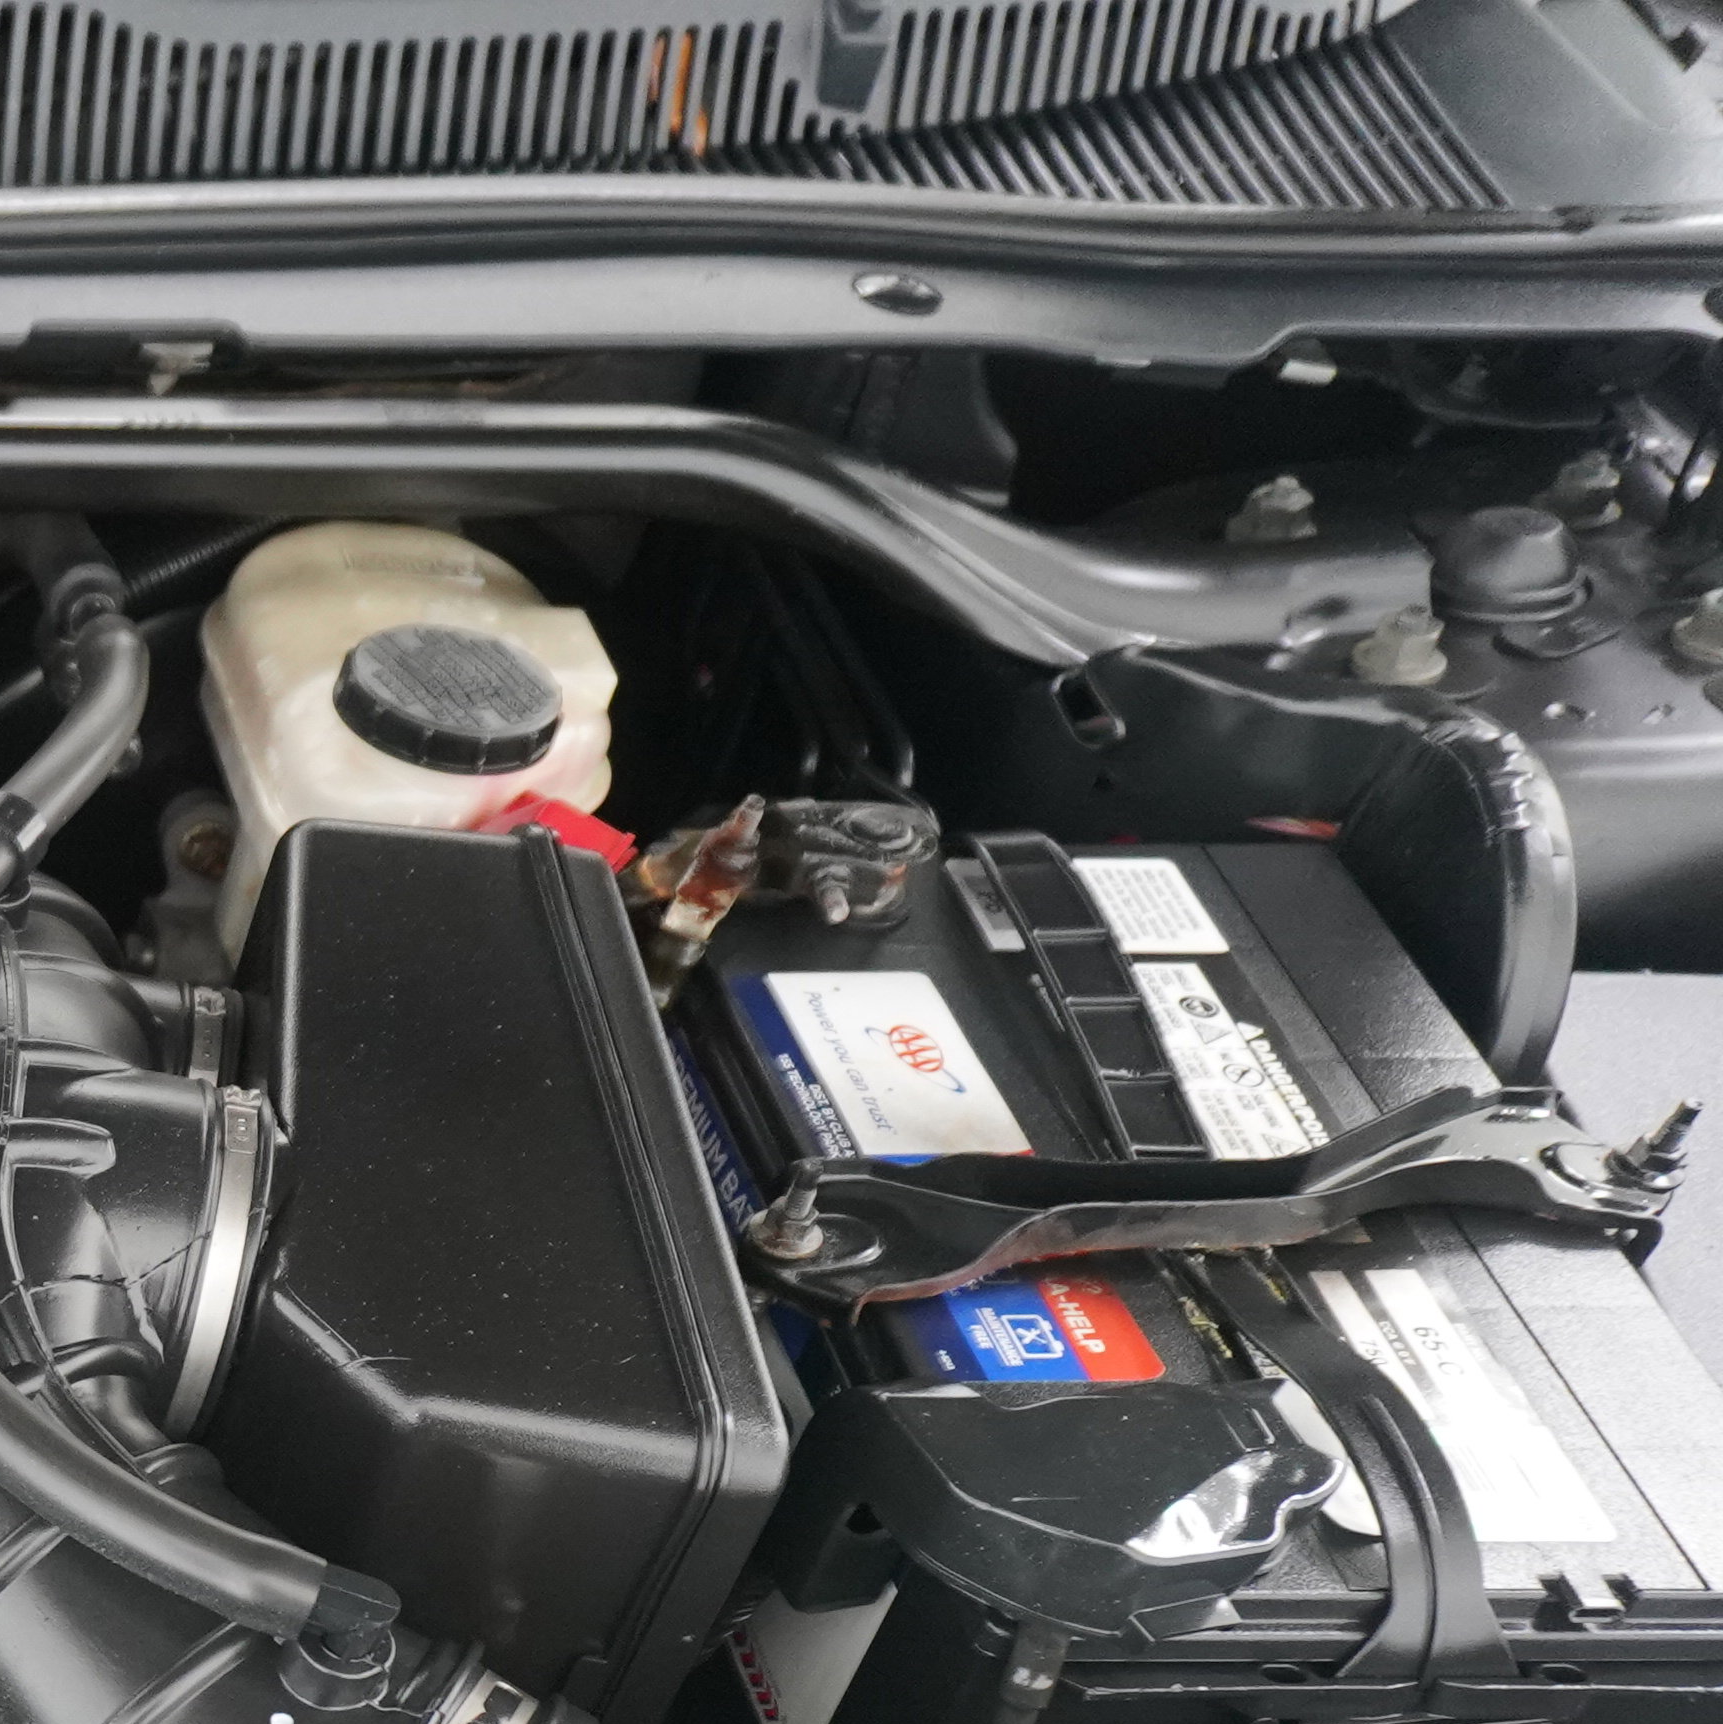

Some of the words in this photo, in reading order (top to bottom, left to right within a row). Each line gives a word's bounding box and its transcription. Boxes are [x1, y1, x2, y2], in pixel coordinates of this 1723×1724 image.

[805, 990, 837, 1034] Power
[824, 1030, 854, 1065] you
[847, 1062, 870, 1092] can
[861, 1096, 894, 1133] trust
[889, 1025, 944, 1073] AAA
[669, 1038, 728, 1178] REMIUM
[786, 1070, 828, 1134] TECHNOLOGY
